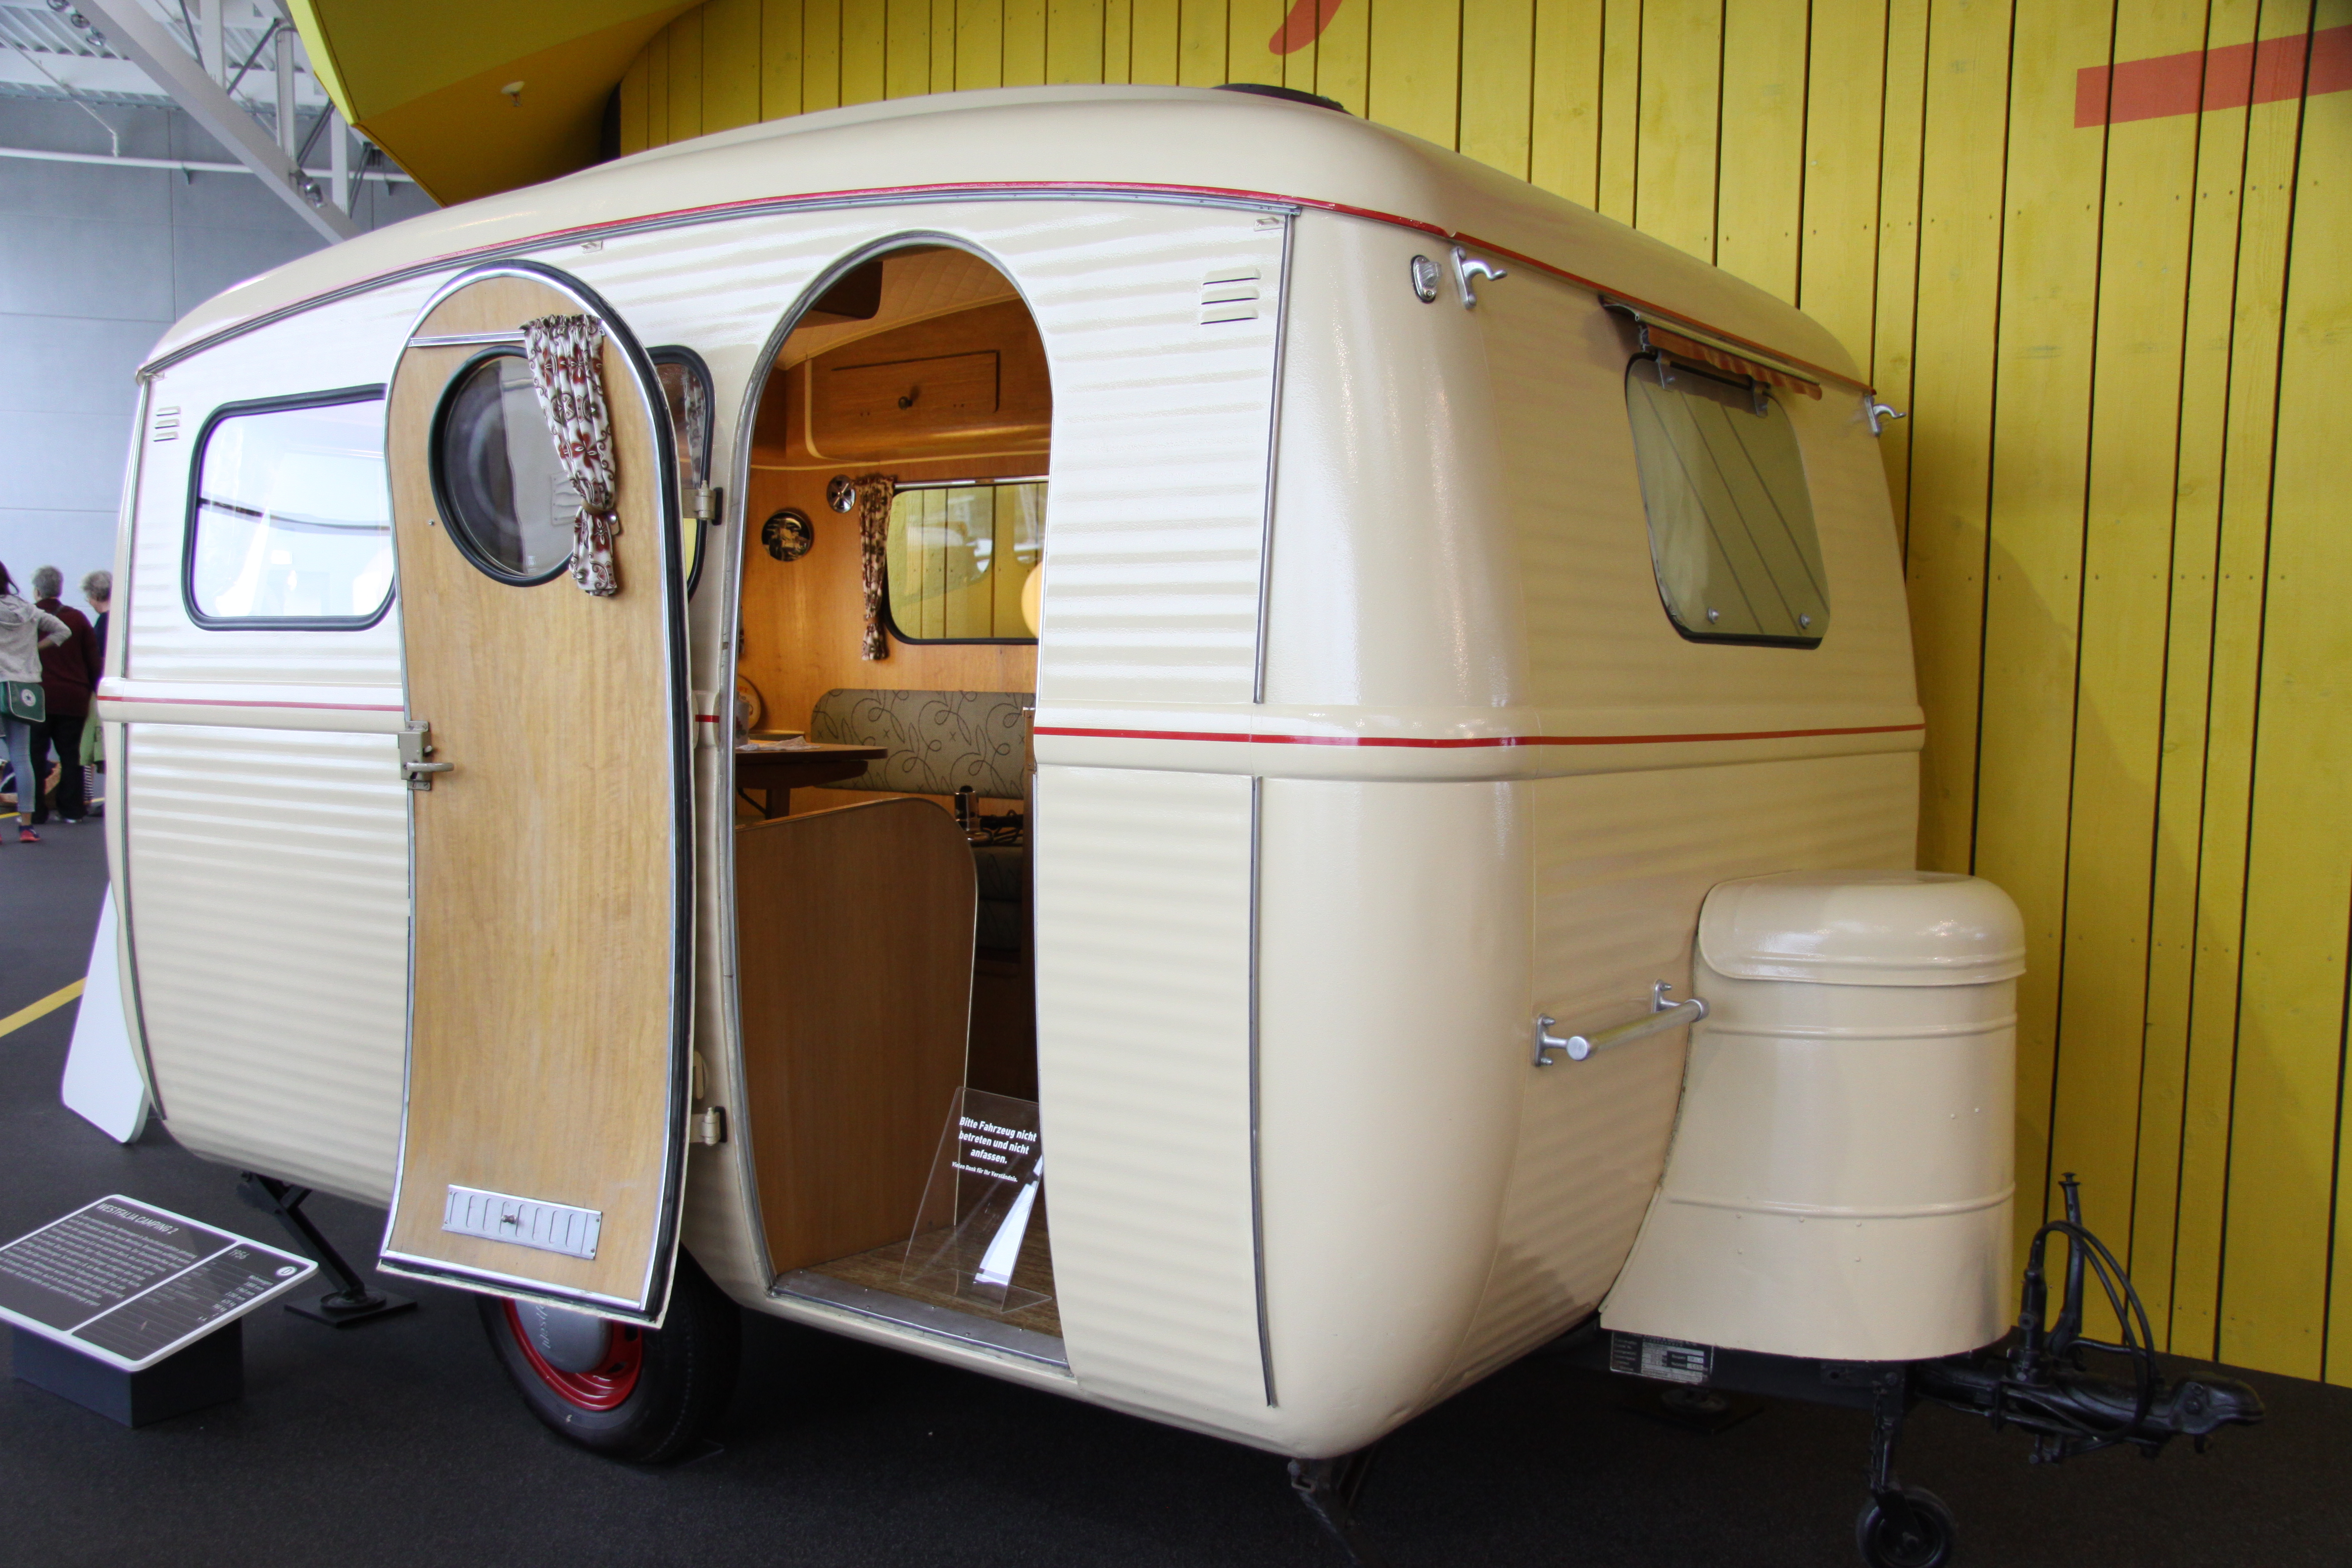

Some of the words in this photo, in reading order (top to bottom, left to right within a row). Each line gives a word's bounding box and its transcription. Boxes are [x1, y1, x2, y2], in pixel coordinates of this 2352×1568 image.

[959, 1116, 978, 1128] Bitte
[979, 1121, 1016, 1139] Fahrzeug
[1016, 1129, 1037, 1142] nicht
[958, 1130, 992, 1146] betreten
[993, 1139, 1009, 1150] und
[1009, 1142, 1029, 1154] nicht
[970, 1149, 1007, 1164] anfassen.
[952, 1161, 965, 1170] Vielen
[991, 1171, 1018, 1182] Verständnis.
[96, 1203, 139, 1222] WESTFALIA
[134, 1216, 173, 1233] CAMPING
[228, 1249, 250, 1260] 1956
